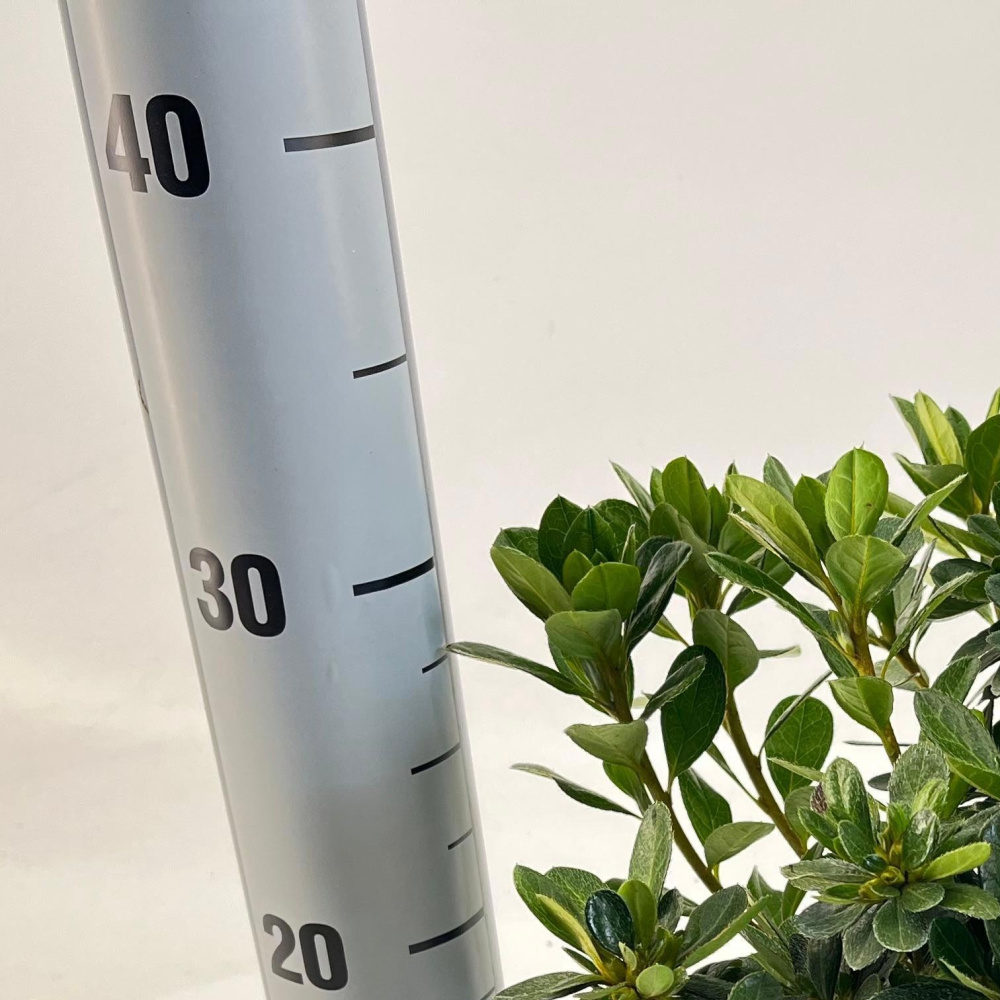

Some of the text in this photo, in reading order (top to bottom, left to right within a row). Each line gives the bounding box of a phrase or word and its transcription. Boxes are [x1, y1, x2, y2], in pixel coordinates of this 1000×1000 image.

[105, 93, 210, 198] 40
[189, 547, 287, 637] 30
[262, 913, 349, 991] 20
